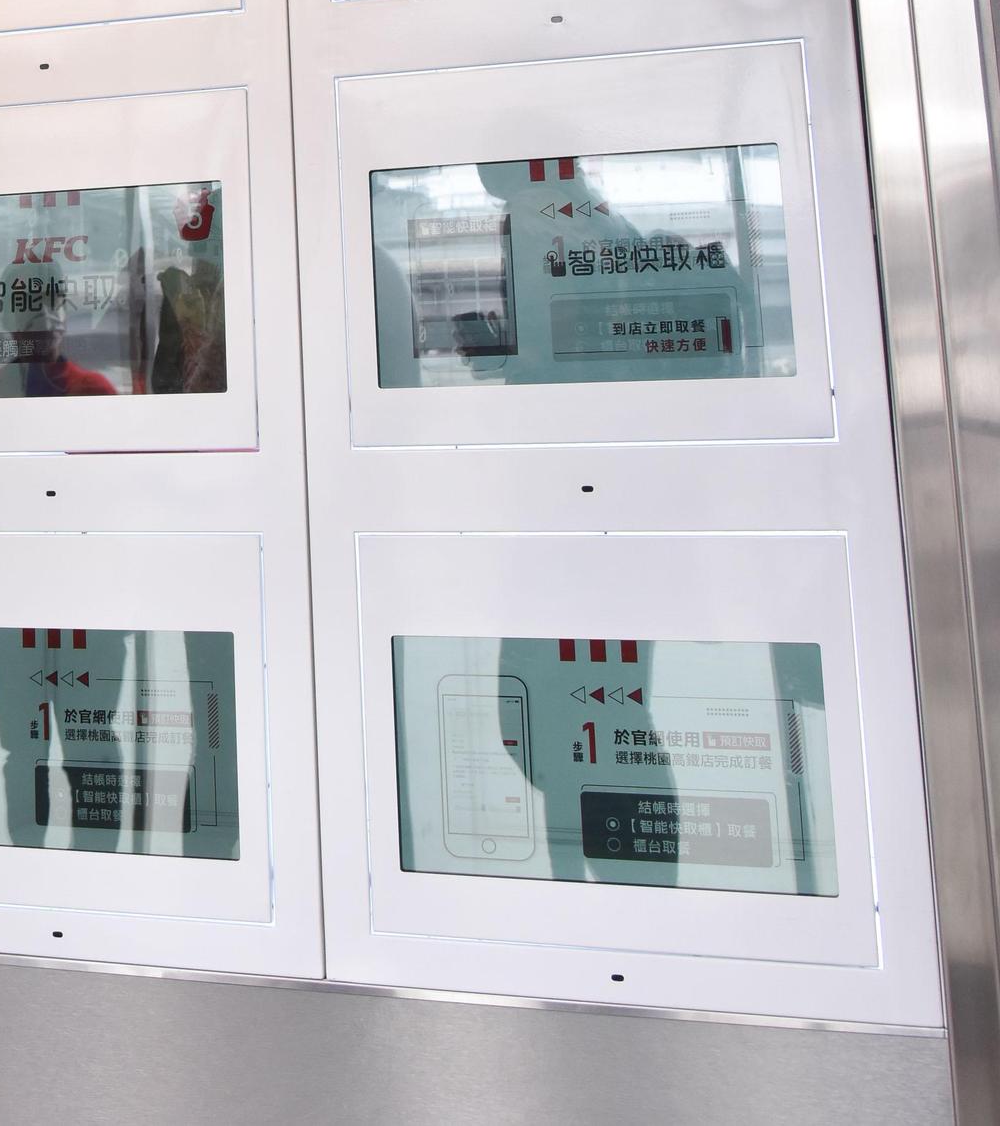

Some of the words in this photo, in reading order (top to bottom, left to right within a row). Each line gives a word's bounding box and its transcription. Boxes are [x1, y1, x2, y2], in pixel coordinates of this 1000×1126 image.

[12, 235, 89, 265] KFC
[568, 240, 728, 276] 智能快取櫃
[612, 319, 707, 337] 到店立即取餐
[644, 338, 708, 354] 快速方便
[38, 701, 51, 741] 1
[582, 721, 597, 765] 1
[613, 728, 700, 749] 於官網使用
[615, 749, 774, 772] 選擇桃園高鐵店完成訂餐
